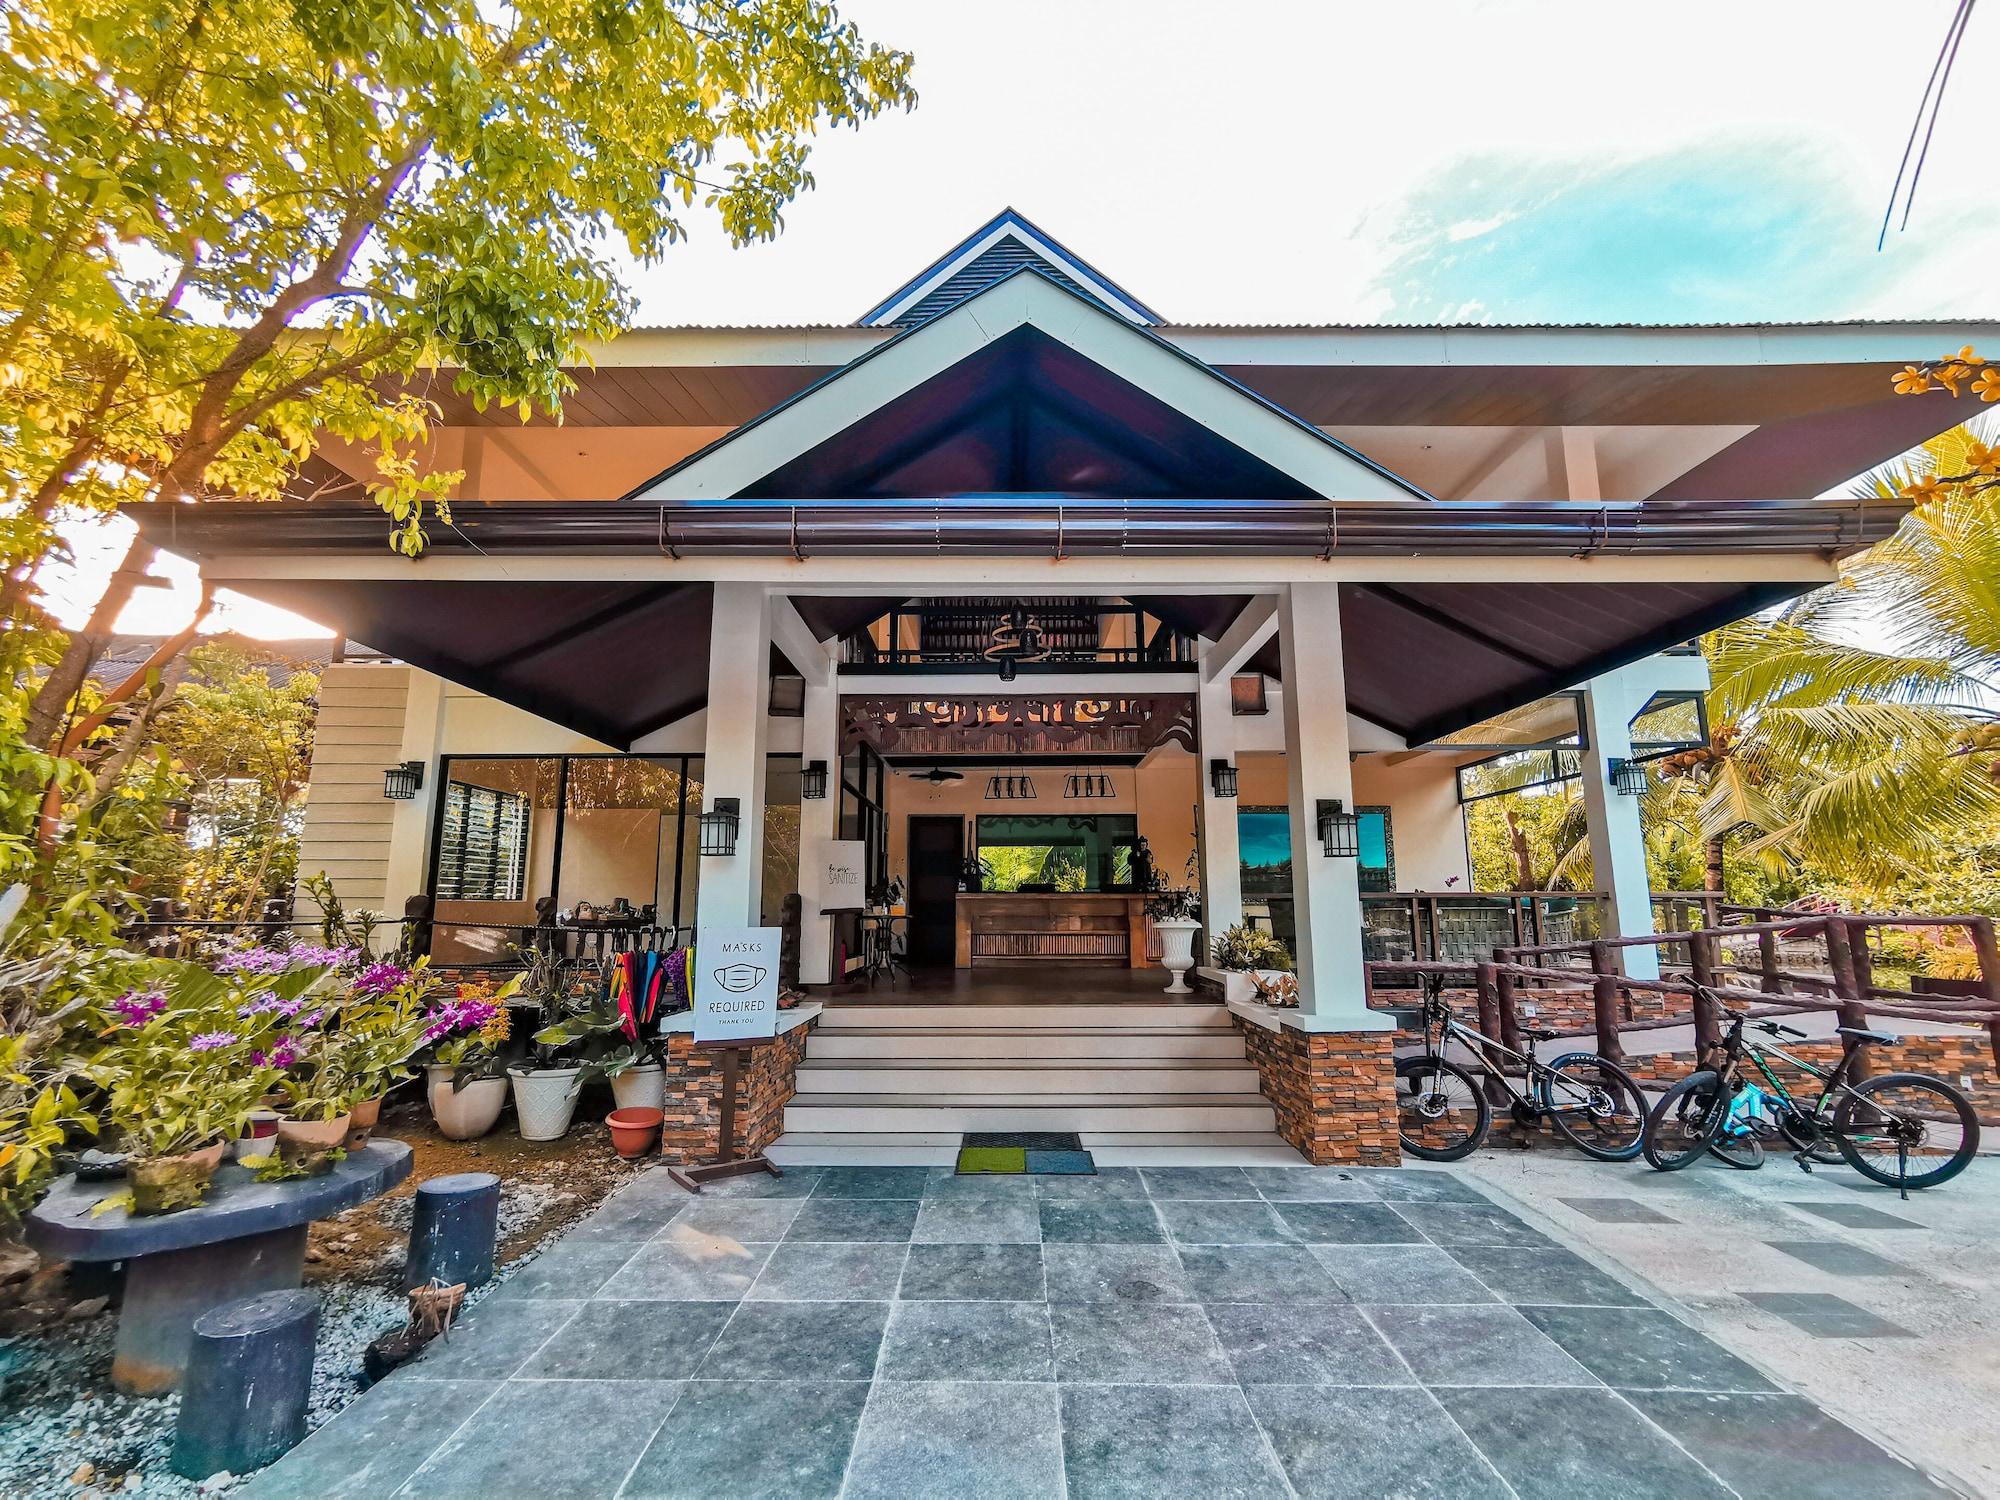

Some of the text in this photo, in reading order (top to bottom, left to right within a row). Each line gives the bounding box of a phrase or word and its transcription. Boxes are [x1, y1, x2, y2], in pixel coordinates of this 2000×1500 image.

[828, 872, 859, 885] SANITIZE
[722, 943, 763, 953] MASKS
[708, 1000, 766, 1014] REQUIRED
